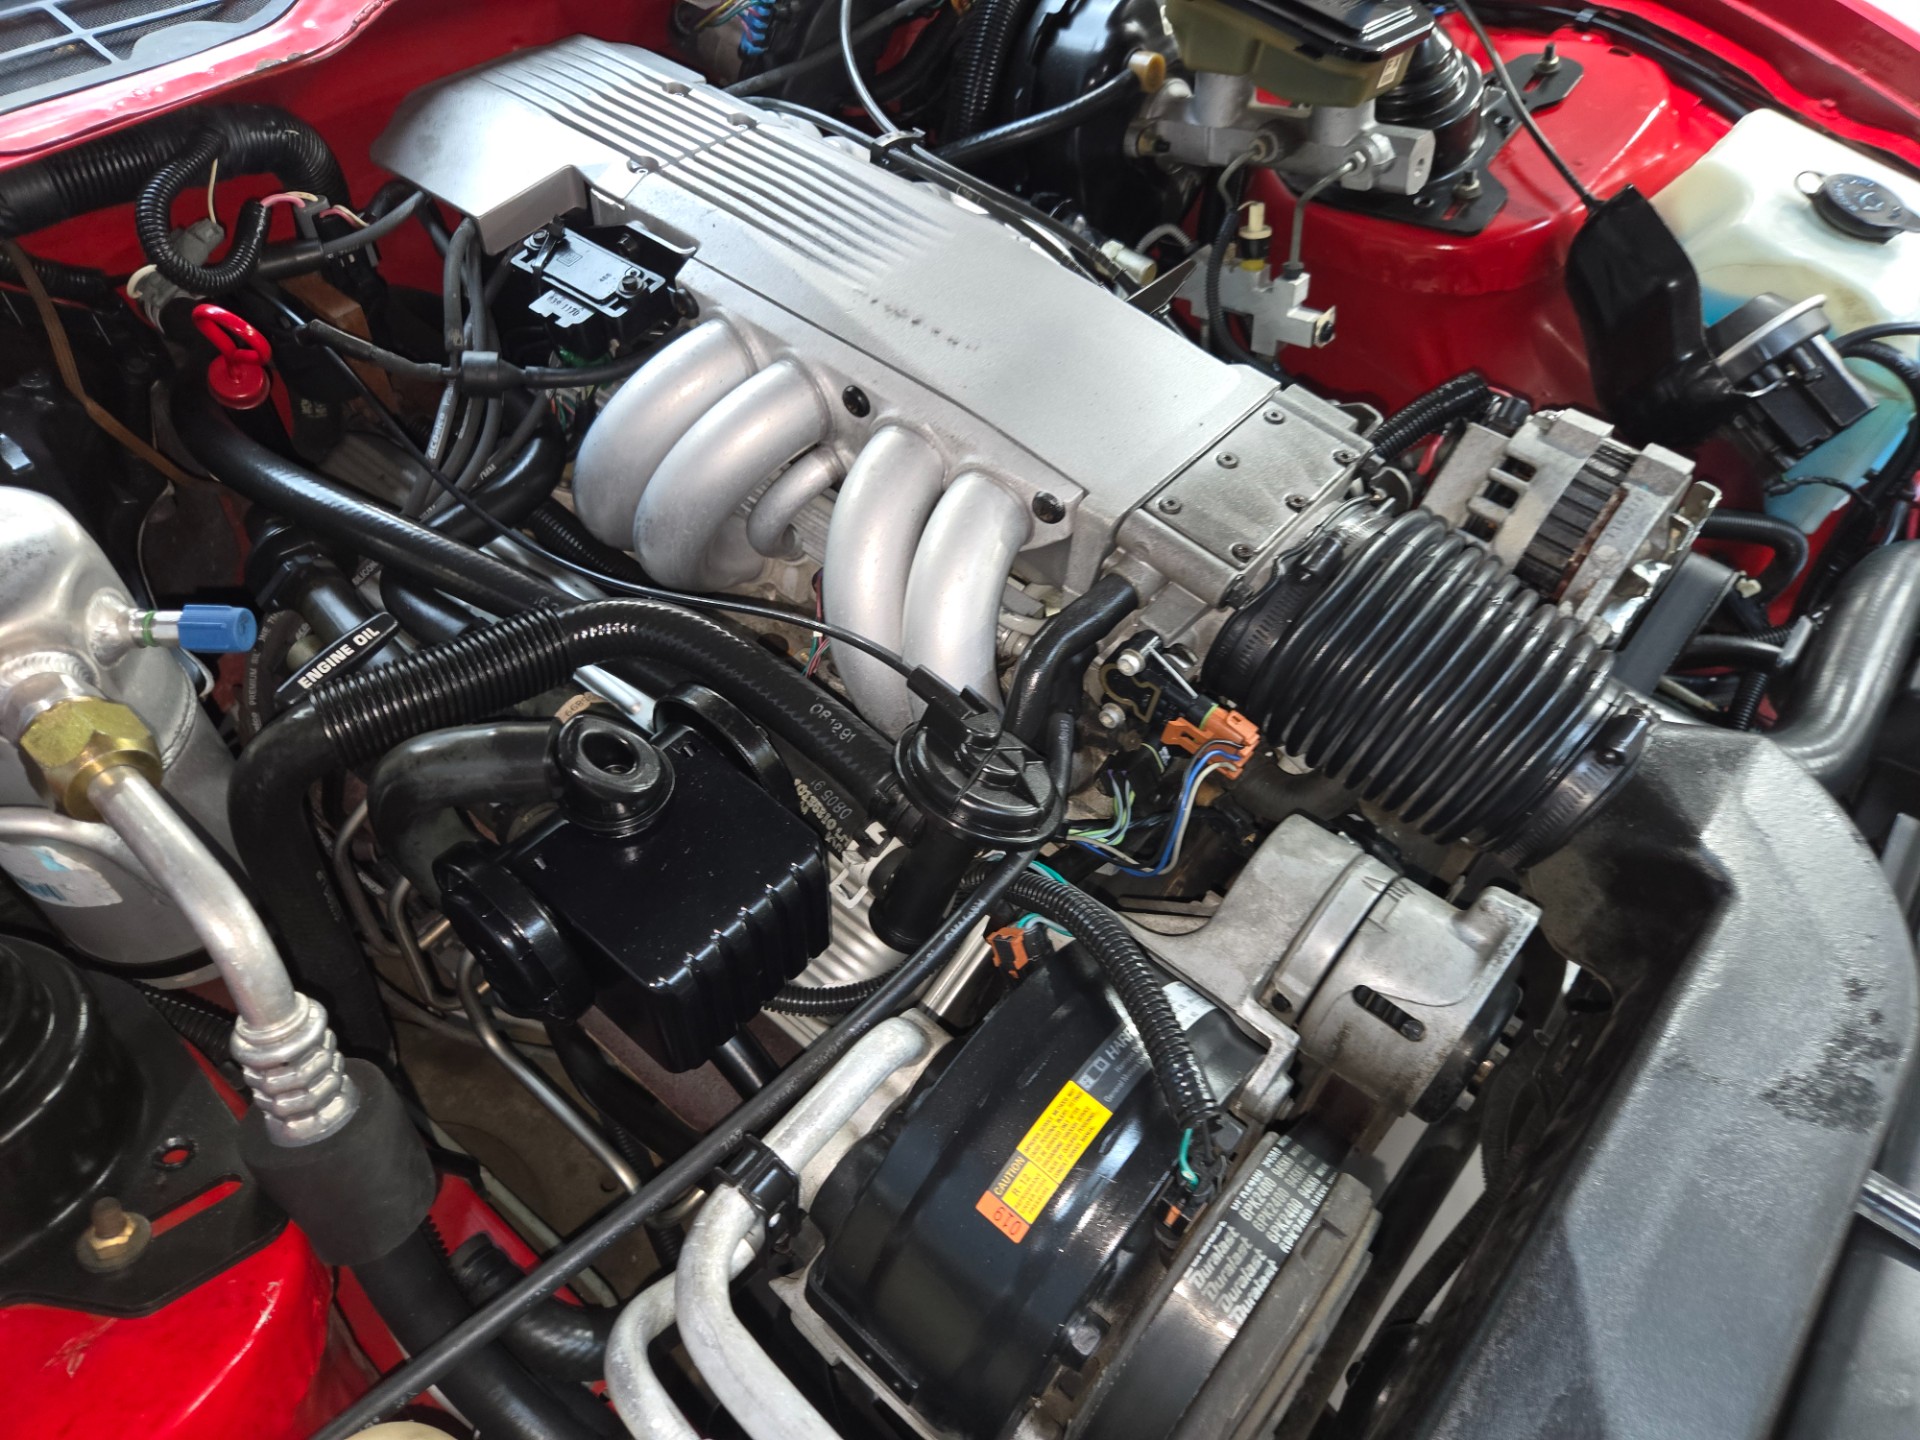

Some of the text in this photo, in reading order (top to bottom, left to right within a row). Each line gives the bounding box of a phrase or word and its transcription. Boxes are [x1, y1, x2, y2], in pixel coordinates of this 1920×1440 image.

[296, 642, 355, 689] ENGINE
[351, 626, 380, 647] OIL
[991, 1155, 1025, 1196] CAUTION
[1186, 1225, 1240, 1290] Duralast
[1237, 1175, 1277, 1222] 6PK2400
[1200, 1236, 1253, 1301] Duralast
[1251, 1186, 1291, 1233] 6PK2400
[1214, 1248, 1267, 1313] Duralast
[1263, 1196, 1304, 1244] 6PK2400
